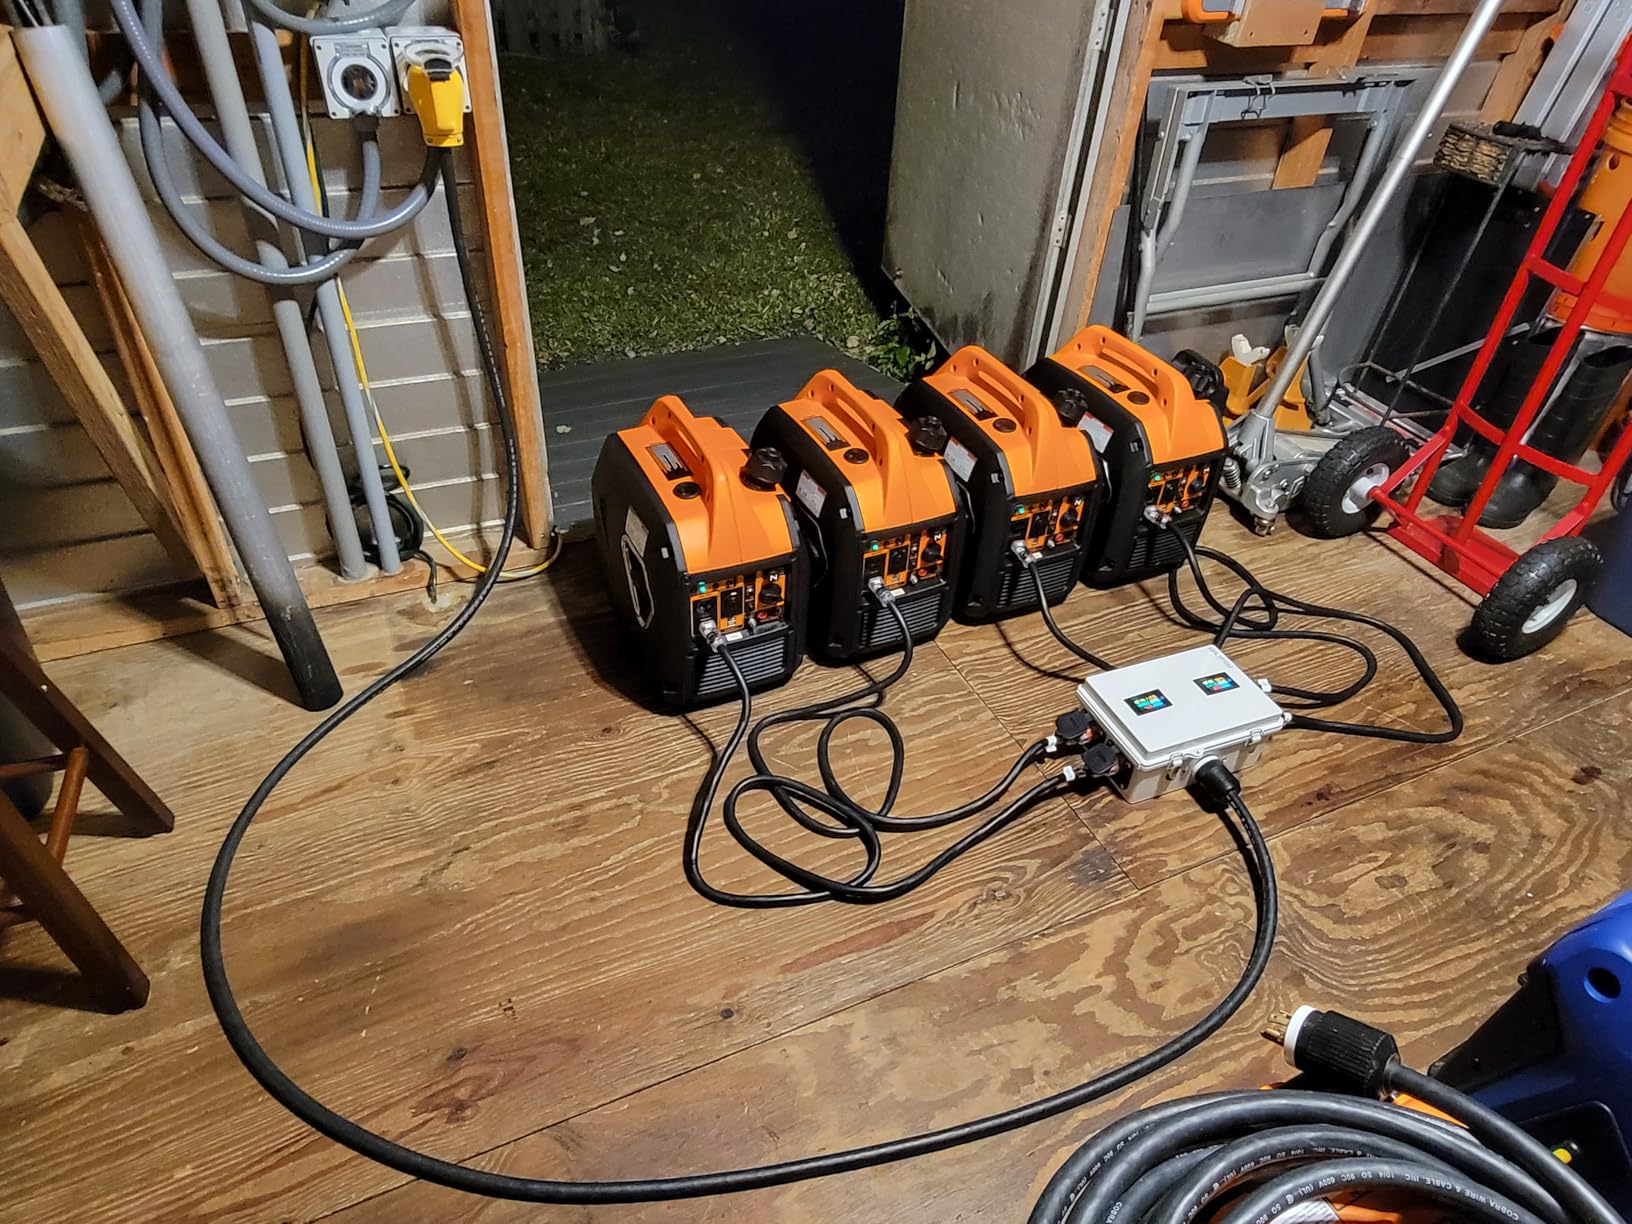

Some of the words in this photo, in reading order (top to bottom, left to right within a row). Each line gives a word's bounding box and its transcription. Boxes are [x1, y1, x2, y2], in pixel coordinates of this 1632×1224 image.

[1318, 1176, 1336, 1188] 600V
[1463, 1188, 1487, 1204] WIRE
[1106, 1201, 1123, 1224] COBRA
[1488, 1200, 1518, 1220] COBRA
